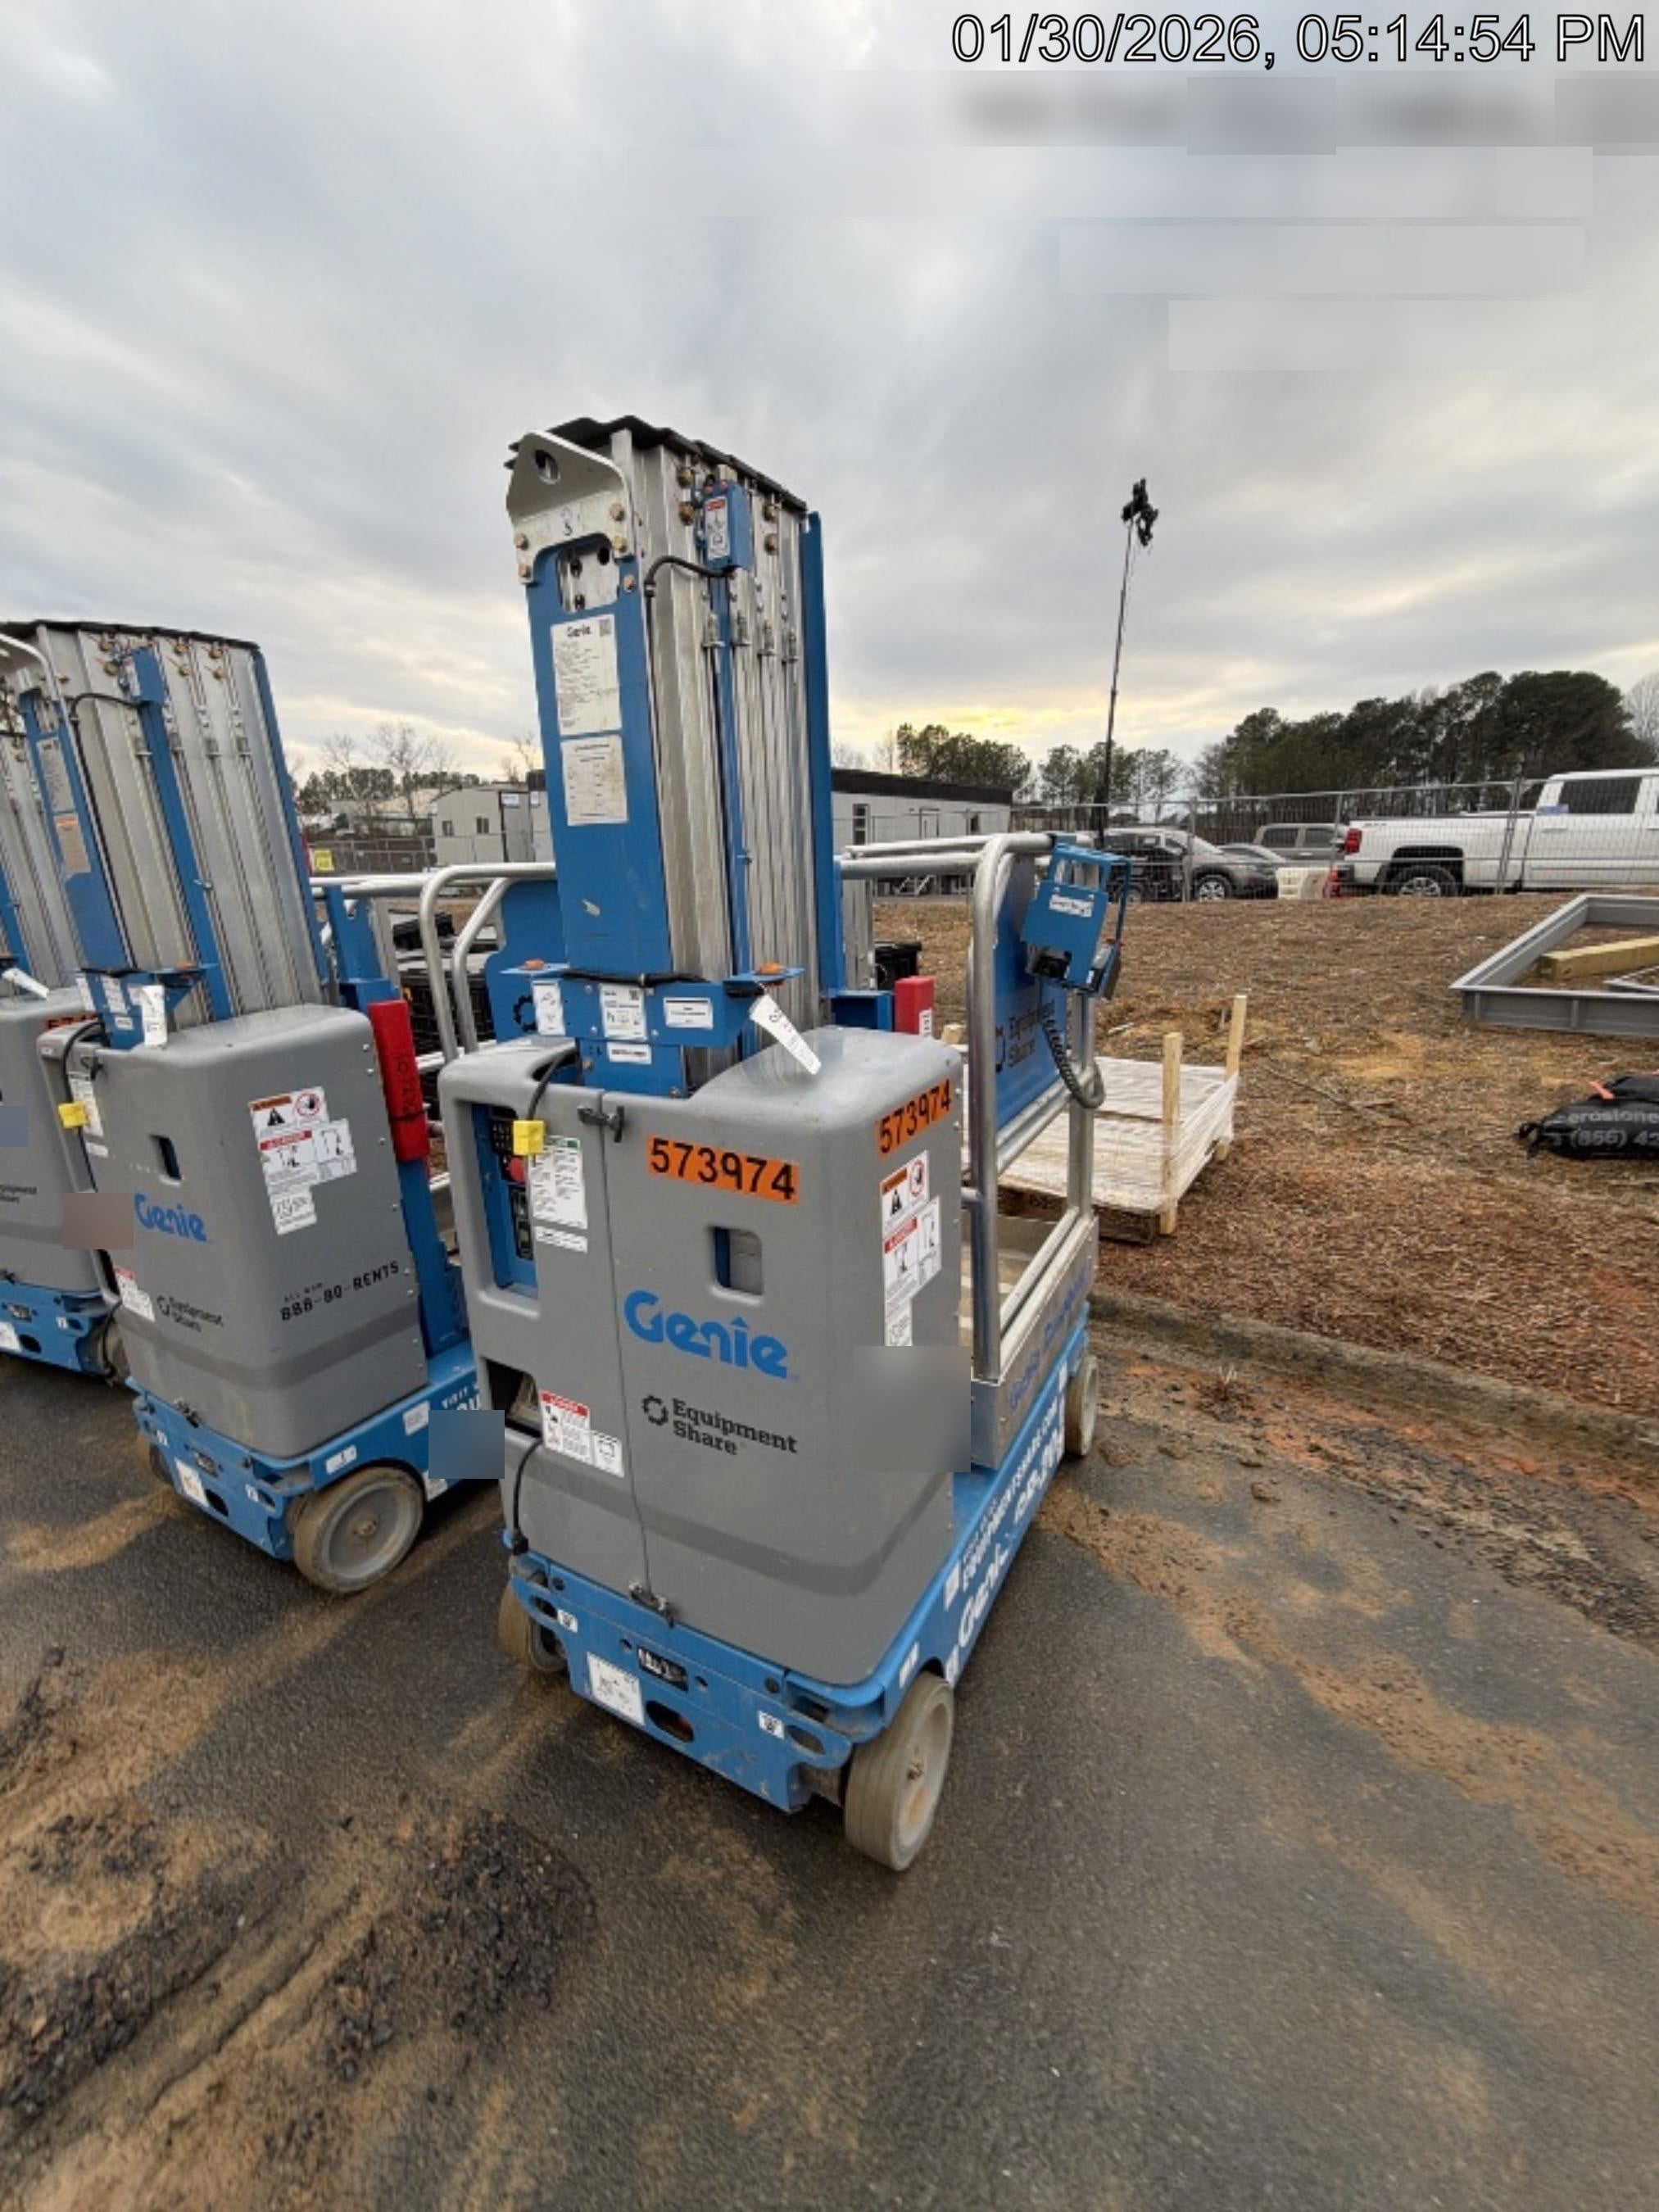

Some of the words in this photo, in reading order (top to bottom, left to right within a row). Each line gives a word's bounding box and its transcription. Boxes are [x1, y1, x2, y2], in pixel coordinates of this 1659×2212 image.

[879, 1078, 951, 1154] 573974
[650, 1137, 795, 1200] 573974
[134, 1193, 207, 1242] Genie
[623, 1290, 787, 1379] Genie
[672, 1398, 798, 1453] Equipment
[673, 1419, 738, 1456] Share
